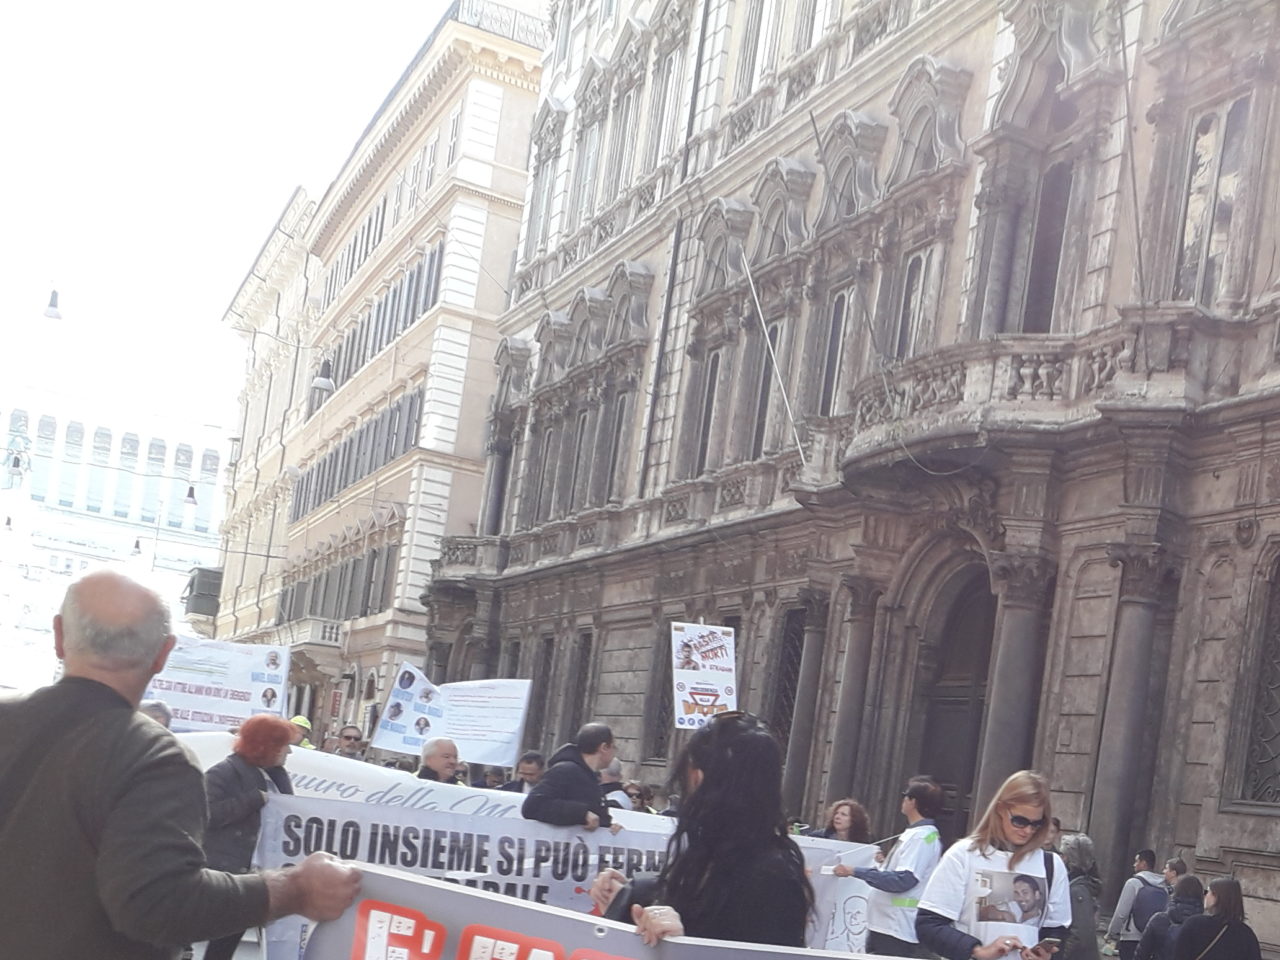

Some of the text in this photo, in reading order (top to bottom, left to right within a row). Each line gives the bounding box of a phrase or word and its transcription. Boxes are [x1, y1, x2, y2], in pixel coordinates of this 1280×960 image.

[281, 814, 361, 860] SOLO
[367, 823, 490, 873] INSIEME
[496, 836, 526, 877] SI
[532, 836, 590, 882] PUÒ
